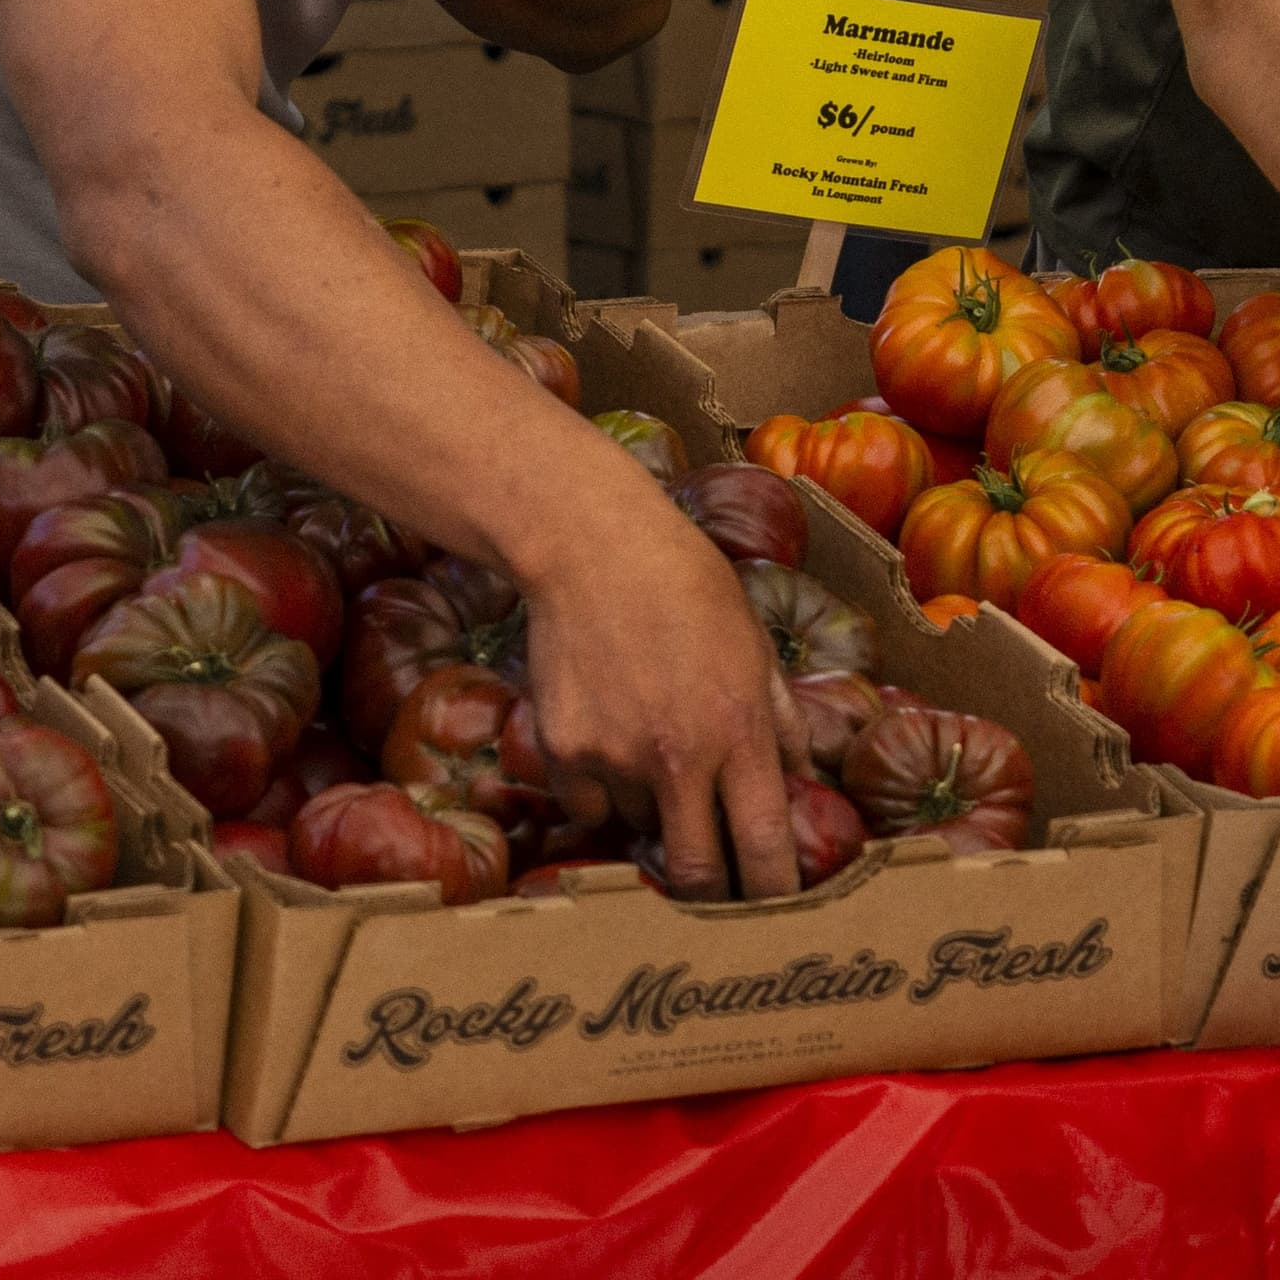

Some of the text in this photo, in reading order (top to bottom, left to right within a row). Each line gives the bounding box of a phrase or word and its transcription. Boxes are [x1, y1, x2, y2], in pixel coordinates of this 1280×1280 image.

[823, 13, 956, 53] Marmande
[853, 48, 915, 67] -Heirloom
[809, 58, 949, 88] -Light Sweet and Firm
[870, 122, 916, 139] pound
[771, 162, 929, 196] Rocky Mountain Fresh
[811, 185, 883, 205] In Longmont
[342, 918, 1112, 1073] Rocky Mountain Fresh
